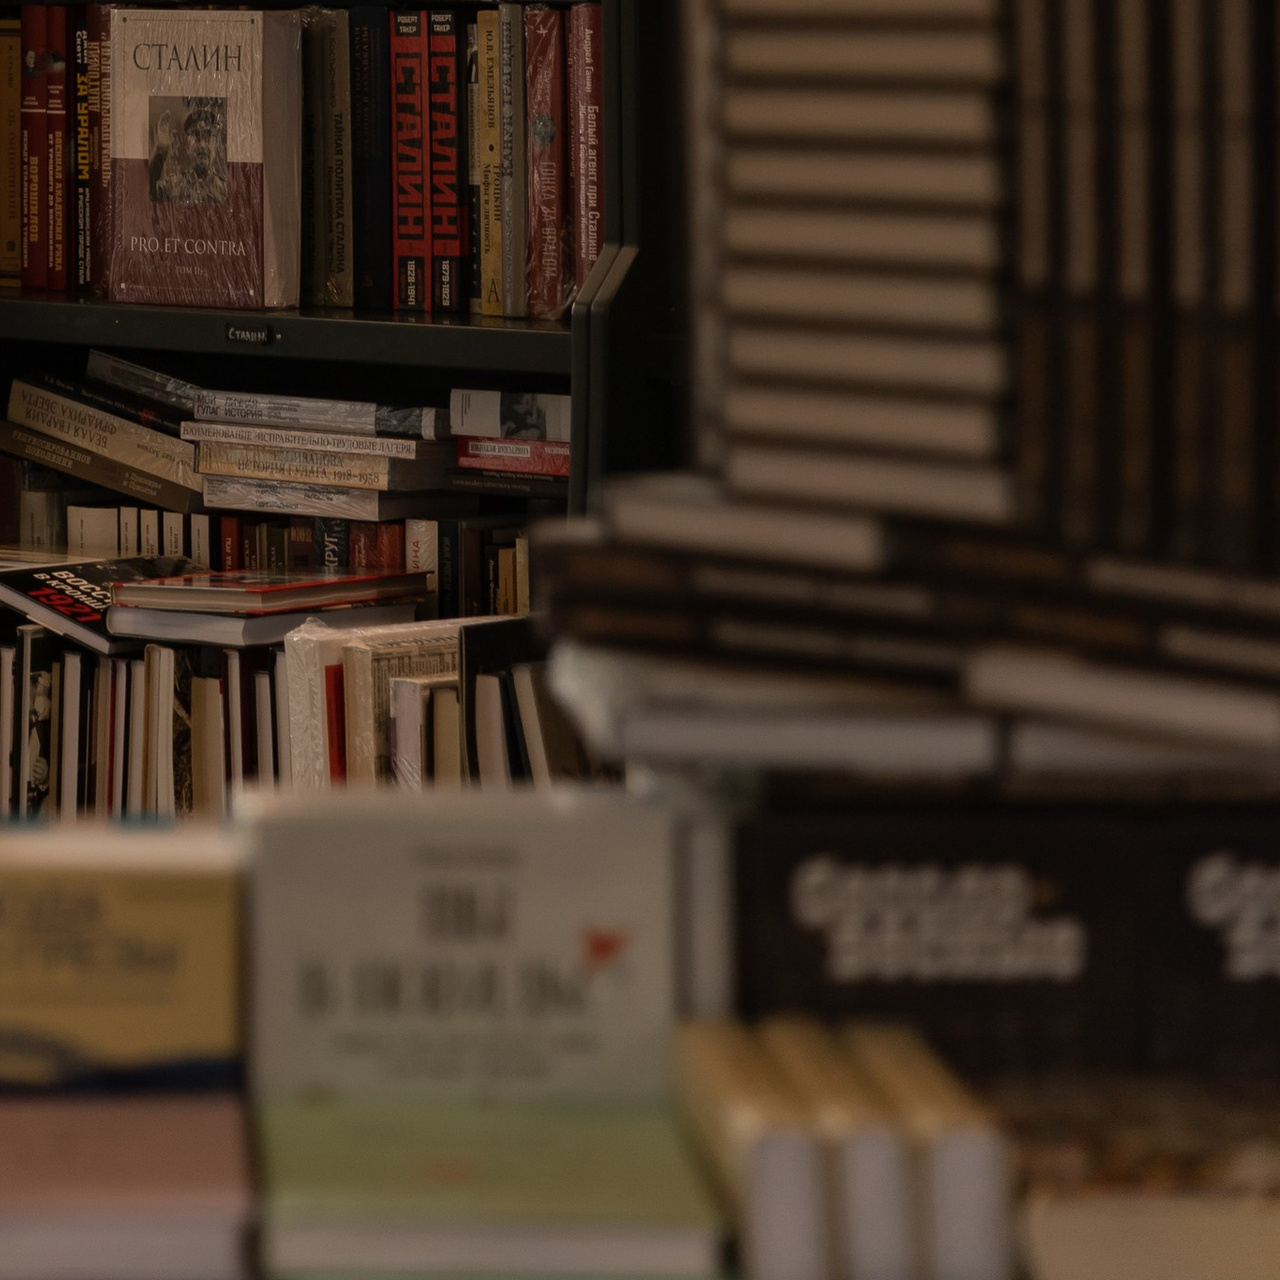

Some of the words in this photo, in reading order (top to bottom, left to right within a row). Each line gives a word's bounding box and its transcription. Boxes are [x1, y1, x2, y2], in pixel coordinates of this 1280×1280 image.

[133, 43, 242, 72] СТАЛИН
[584, 29, 593, 64] Андрей
[77, 73, 90, 94] ЗА
[77, 103, 90, 179] УРАЛОМ
[334, 113, 344, 156] ТАЙНАЯ
[396, 57, 424, 235] СТАЛИН
[431, 56, 457, 235] СТАЛИН
[587, 105, 598, 146] Белый
[541, 161, 556, 201] ГОНКА
[587, 149, 597, 181] агент
[29, 156, 39, 242] ВОРОШИЛОВ
[334, 159, 344, 219] ПОЛИТИКА
[586, 185, 597, 208] при
[131, 236, 159, 252] PRO
[164, 238, 180, 254] ET
[184, 239, 246, 257] CONTRA
[336, 222, 345, 273] СТАЛИНА
[588, 211, 600, 261] Сталине
[407, 260, 416, 306] 1928-1941
[441, 260, 451, 306] 1879-1929
